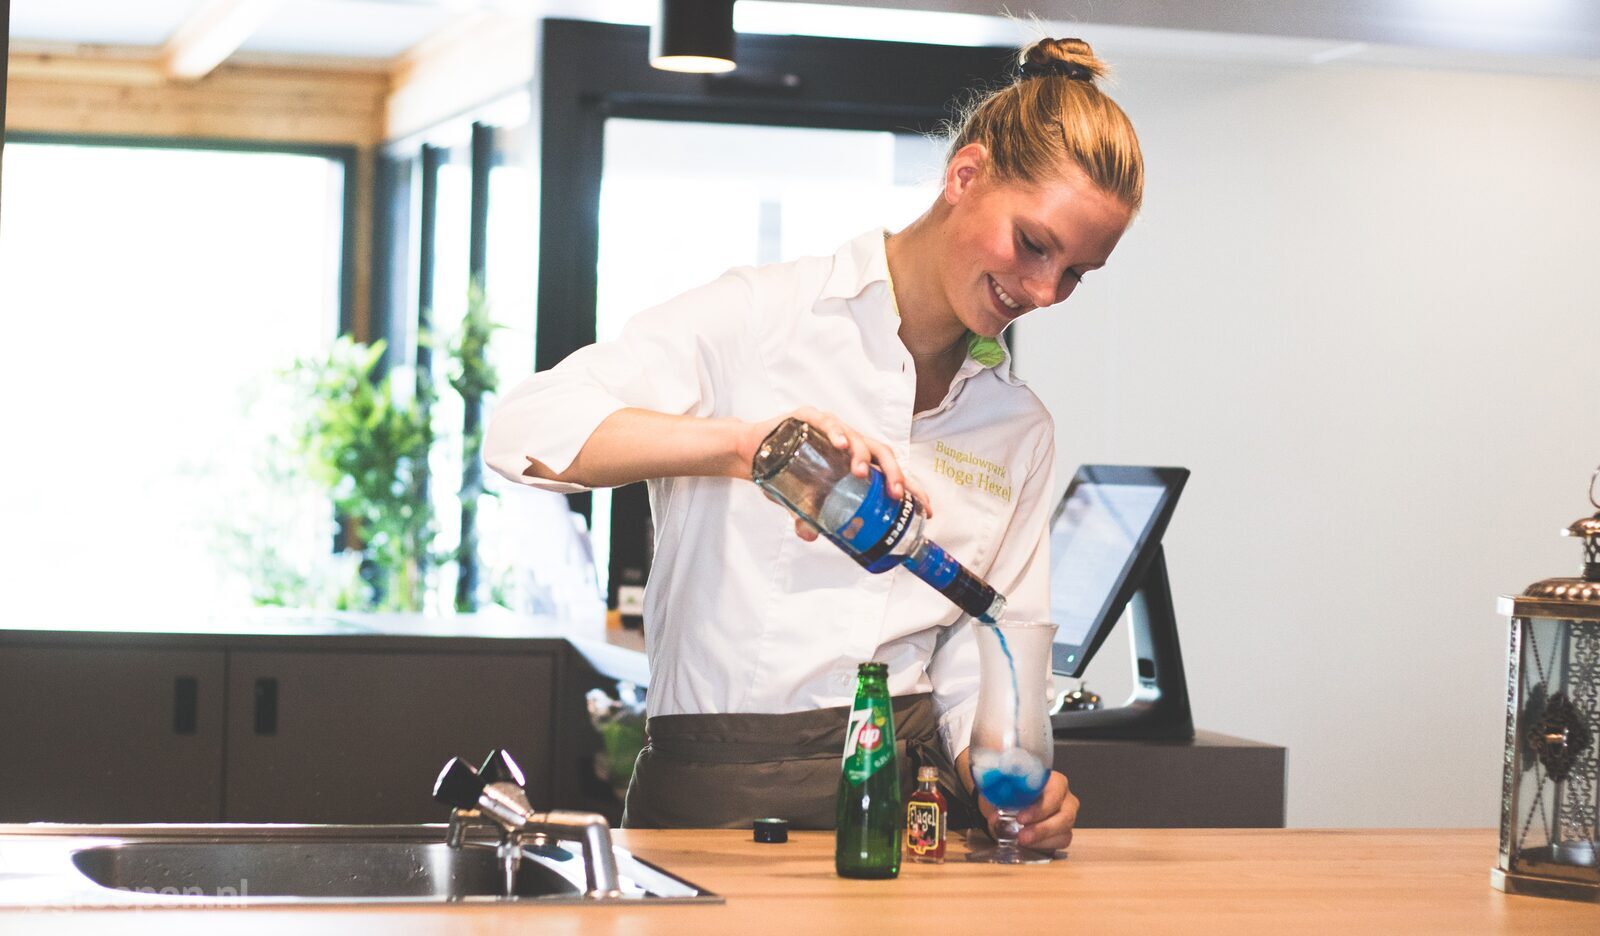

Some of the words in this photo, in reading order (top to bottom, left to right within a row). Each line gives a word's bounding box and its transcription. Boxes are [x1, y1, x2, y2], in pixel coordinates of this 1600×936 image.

[934, 457, 973, 485] Hoge
[978, 473, 1011, 502] Hexel
[936, 441, 1006, 478] Bungalowpark
[885, 500, 914, 546] KUYPER
